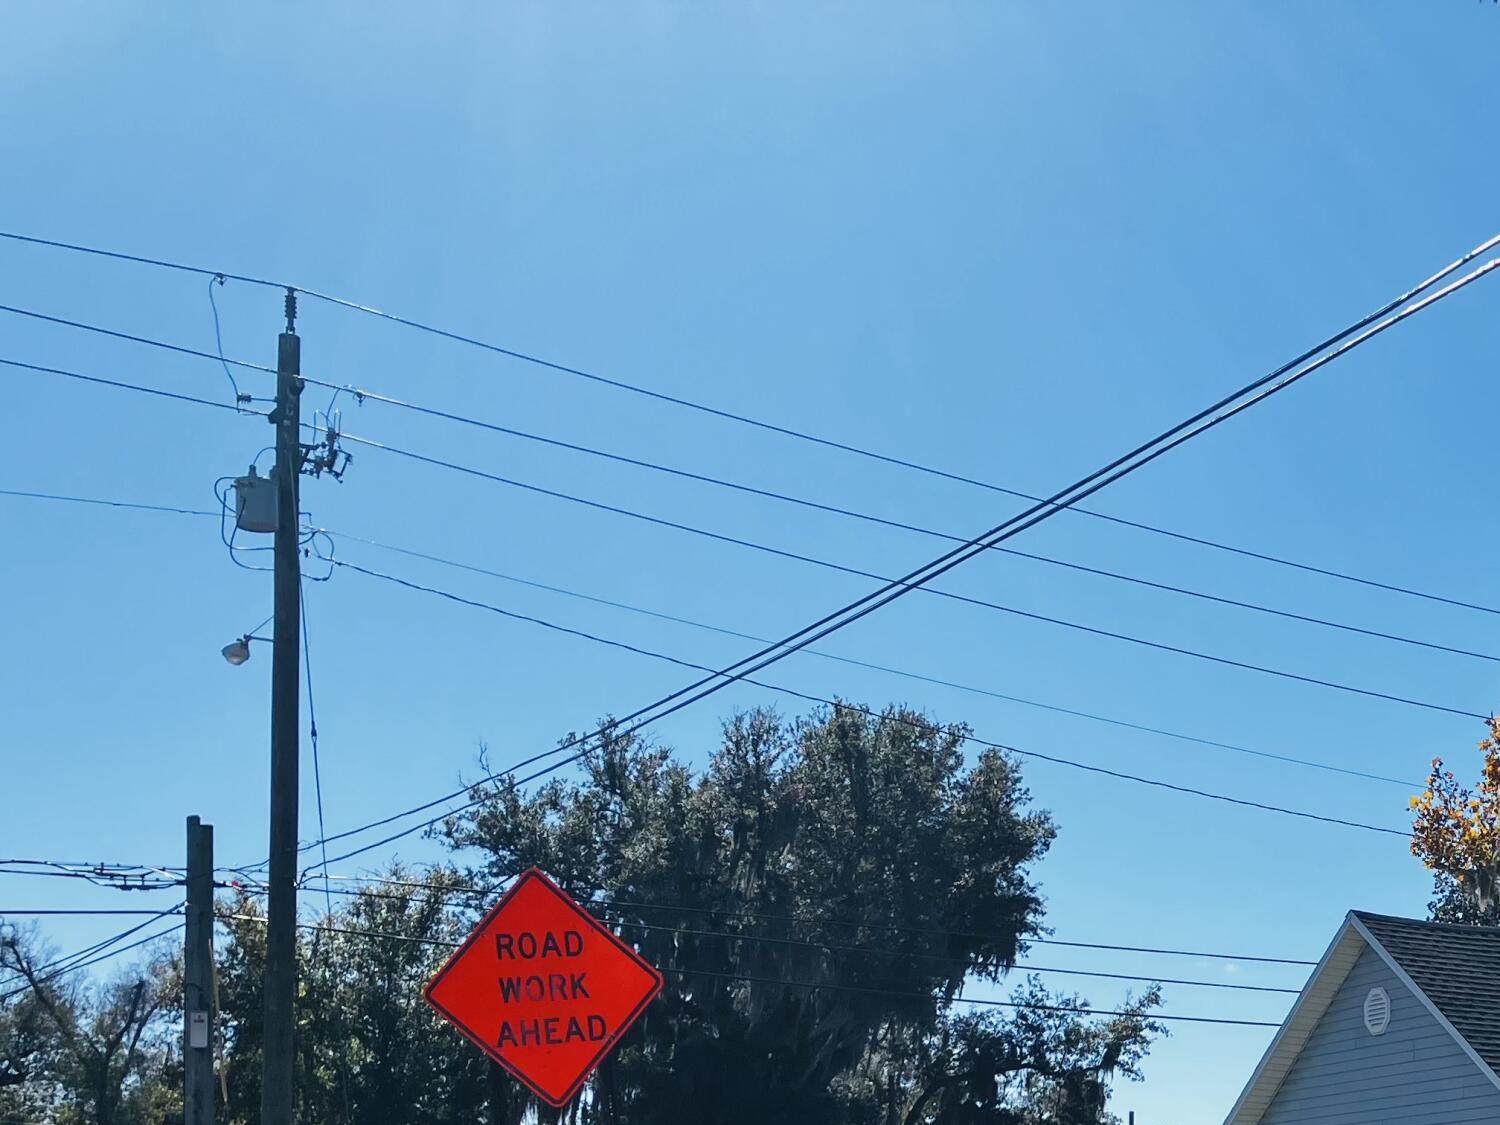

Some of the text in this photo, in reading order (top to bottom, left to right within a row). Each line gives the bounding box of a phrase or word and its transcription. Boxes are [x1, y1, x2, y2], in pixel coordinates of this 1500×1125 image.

[495, 931, 584, 960] ROAD
[498, 972, 590, 1003] WORK
[496, 1014, 607, 1048] AHEAD
